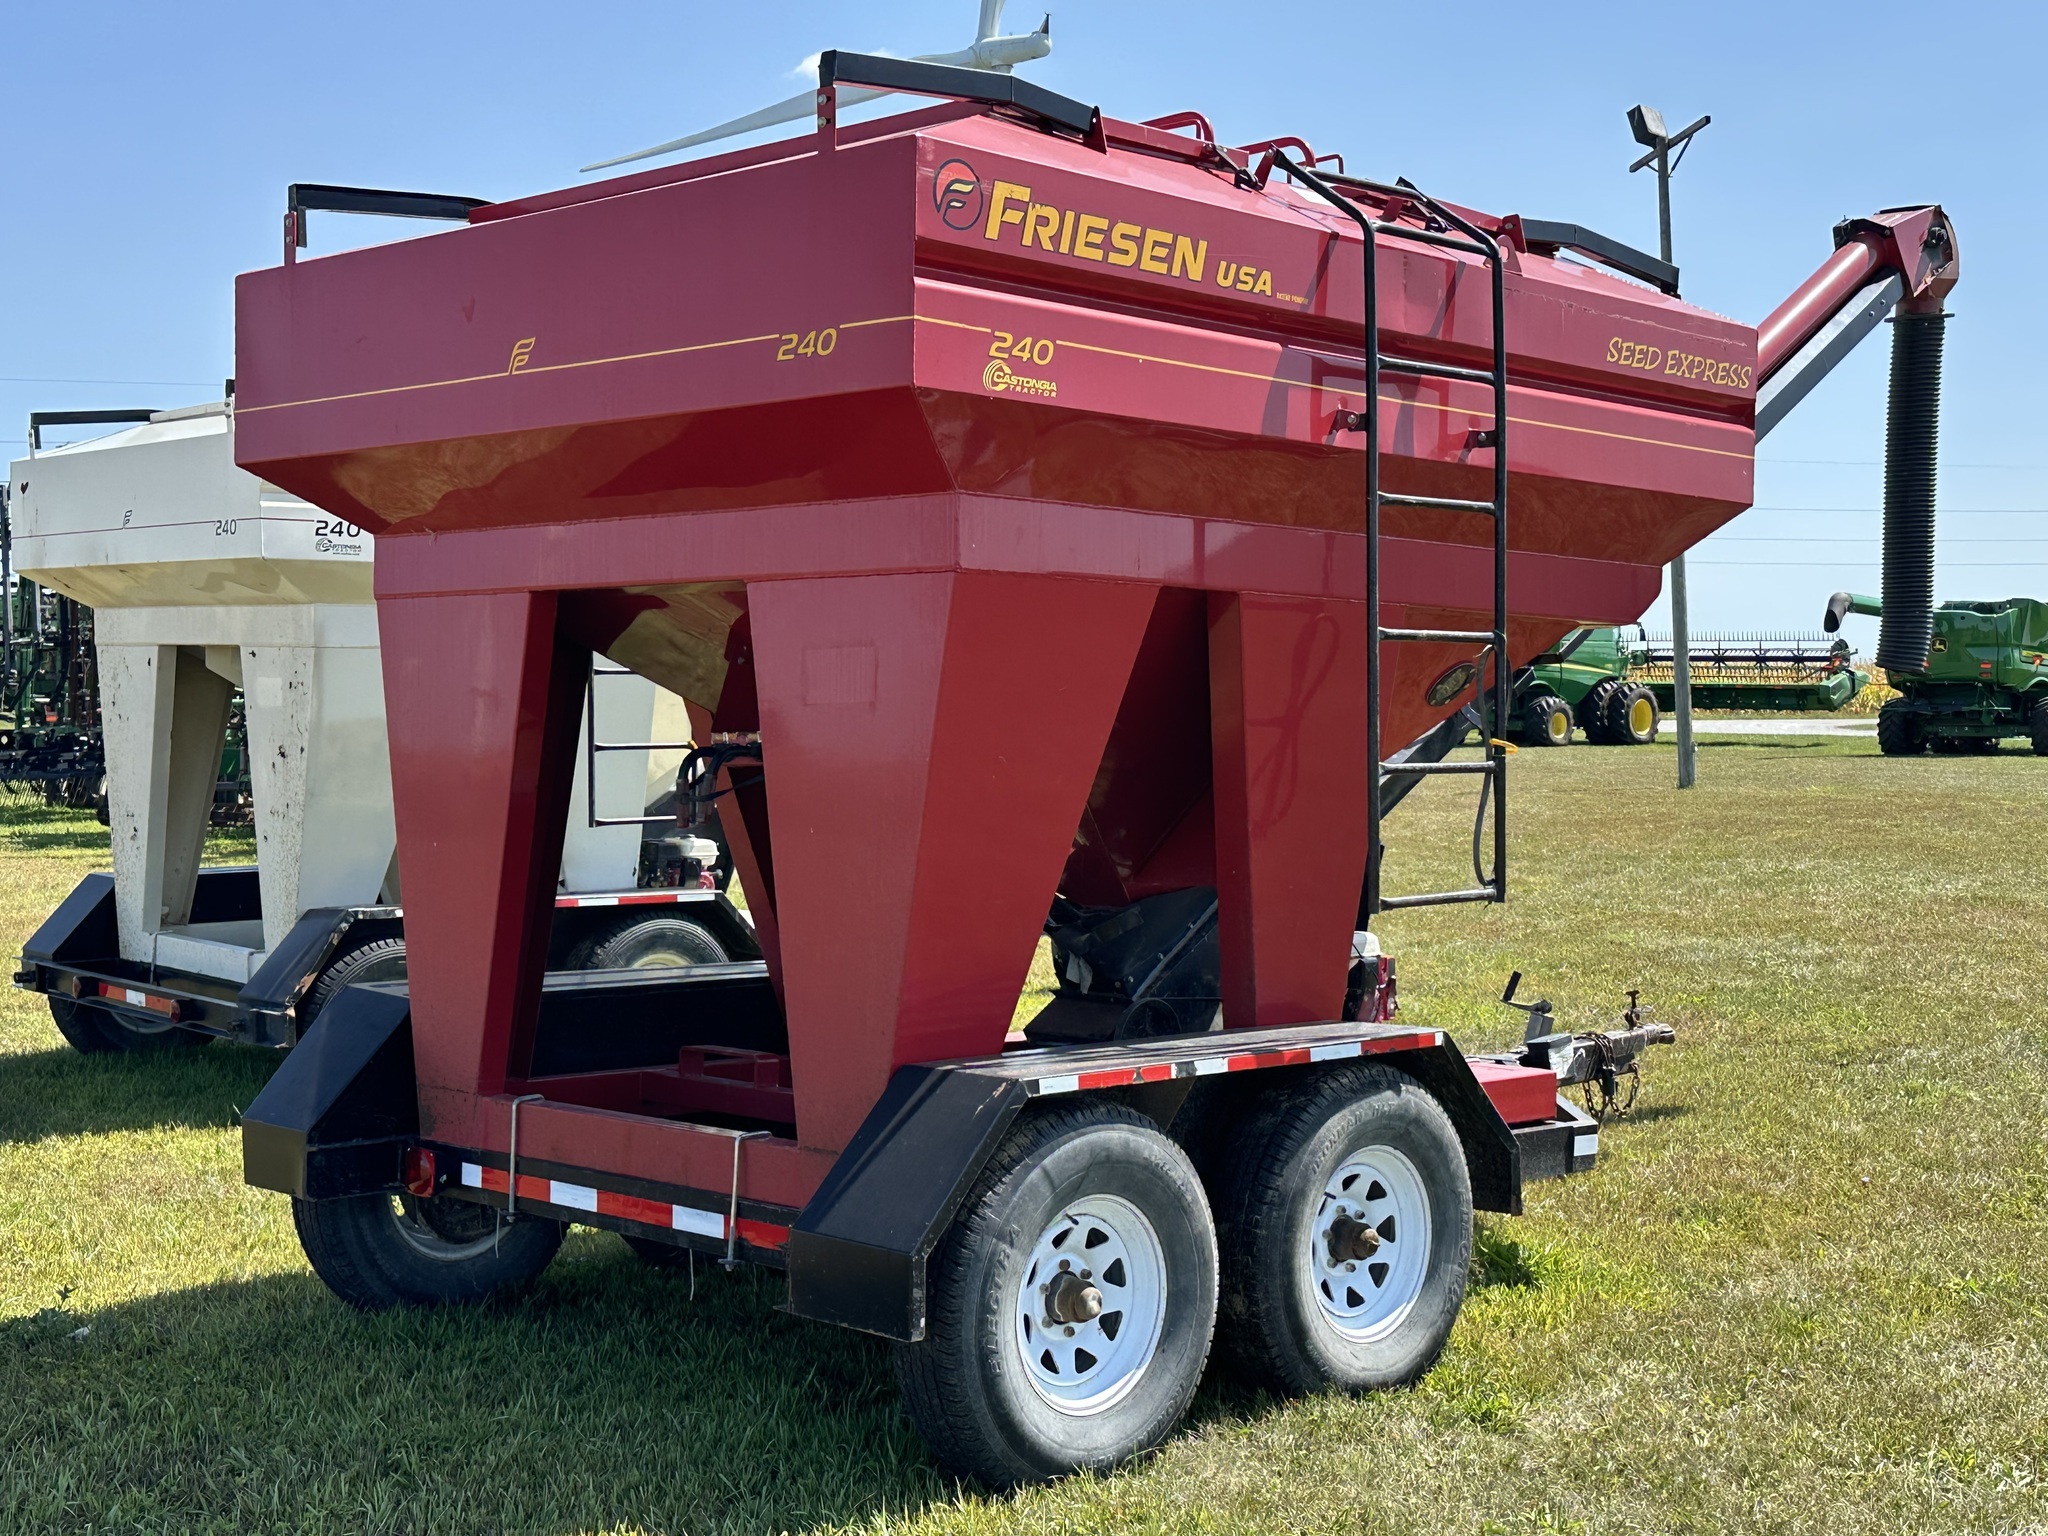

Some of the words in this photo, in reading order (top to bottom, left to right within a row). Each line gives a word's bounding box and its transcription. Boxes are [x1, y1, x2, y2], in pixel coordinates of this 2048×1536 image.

[983, 179, 1209, 282] FRIESEN
[1215, 260, 1273, 297] USA
[777, 328, 838, 362] 240
[988, 331, 1055, 366] 240
[1606, 337, 1662, 370] SEED
[1664, 350, 1752, 389] EXPRESS
[1009, 384, 1057, 397] TRACTOR
[215, 519, 237, 536] 240
[315, 520, 361, 537] 240
